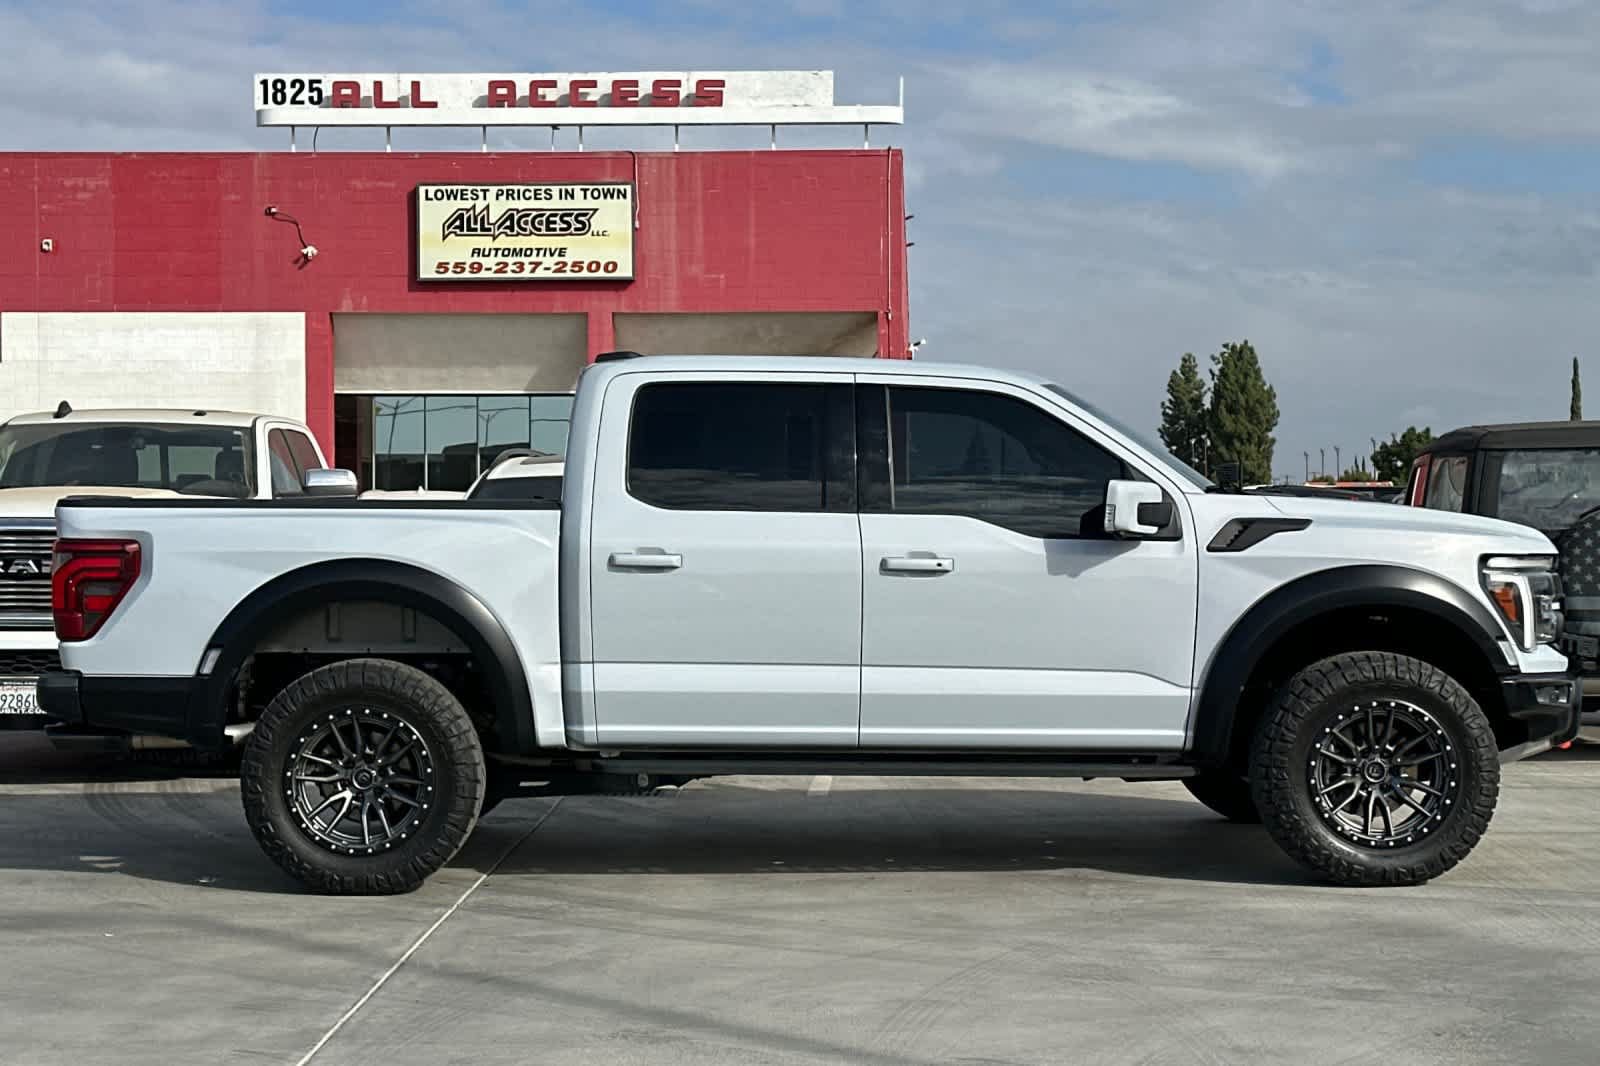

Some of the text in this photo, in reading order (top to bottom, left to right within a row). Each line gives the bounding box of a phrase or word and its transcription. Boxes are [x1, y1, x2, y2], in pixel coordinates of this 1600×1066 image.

[260, 78, 323, 106] 1825
[332, 80, 725, 108] ALL ACCESS
[425, 187, 627, 201] LOWEST PRICES IN TOWN
[442, 204, 495, 242] ALL
[493, 208, 599, 241] ACCESS
[471, 247, 568, 258] AUTOMOTIVE
[434, 260, 618, 274] 559-237-2500
